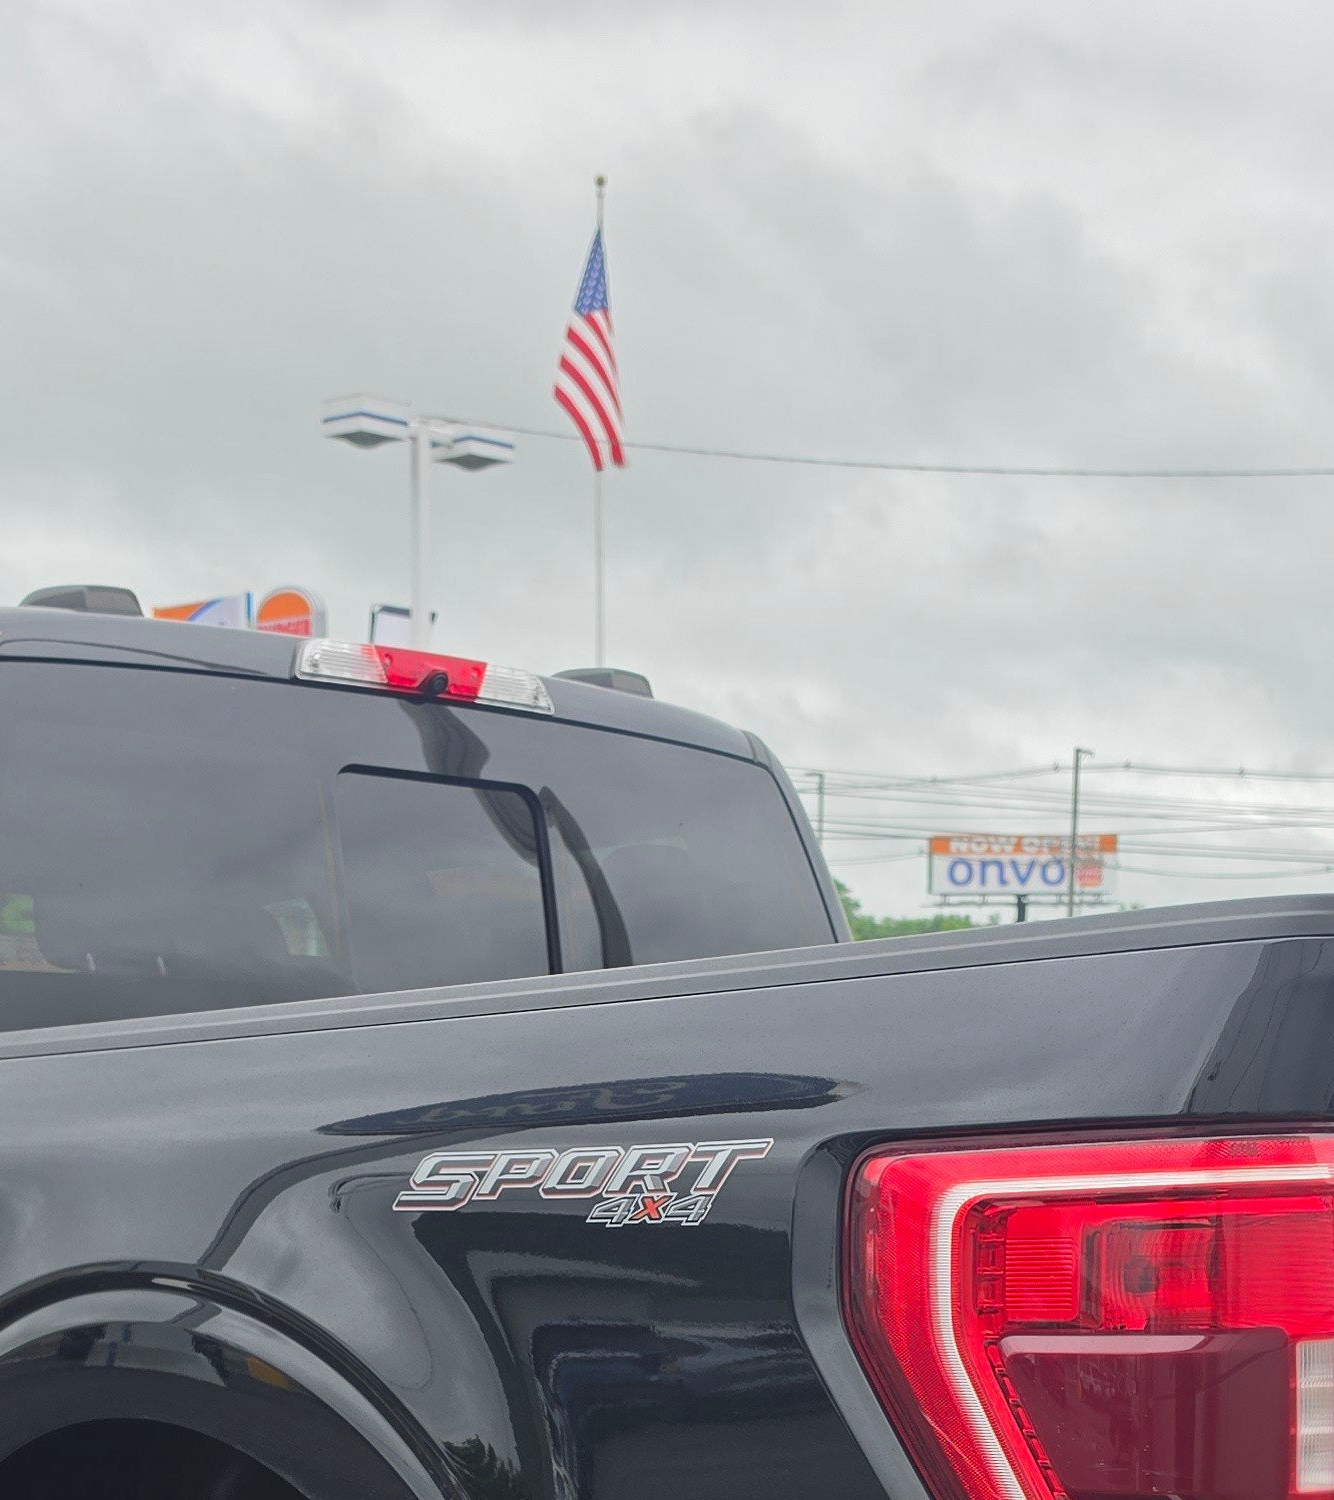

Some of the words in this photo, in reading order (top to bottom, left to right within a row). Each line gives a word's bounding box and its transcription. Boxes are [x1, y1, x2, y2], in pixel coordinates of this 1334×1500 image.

[950, 837, 1016, 854] NOW
[948, 858, 1065, 887] onvo
[392, 1138, 774, 1211] SPORT
